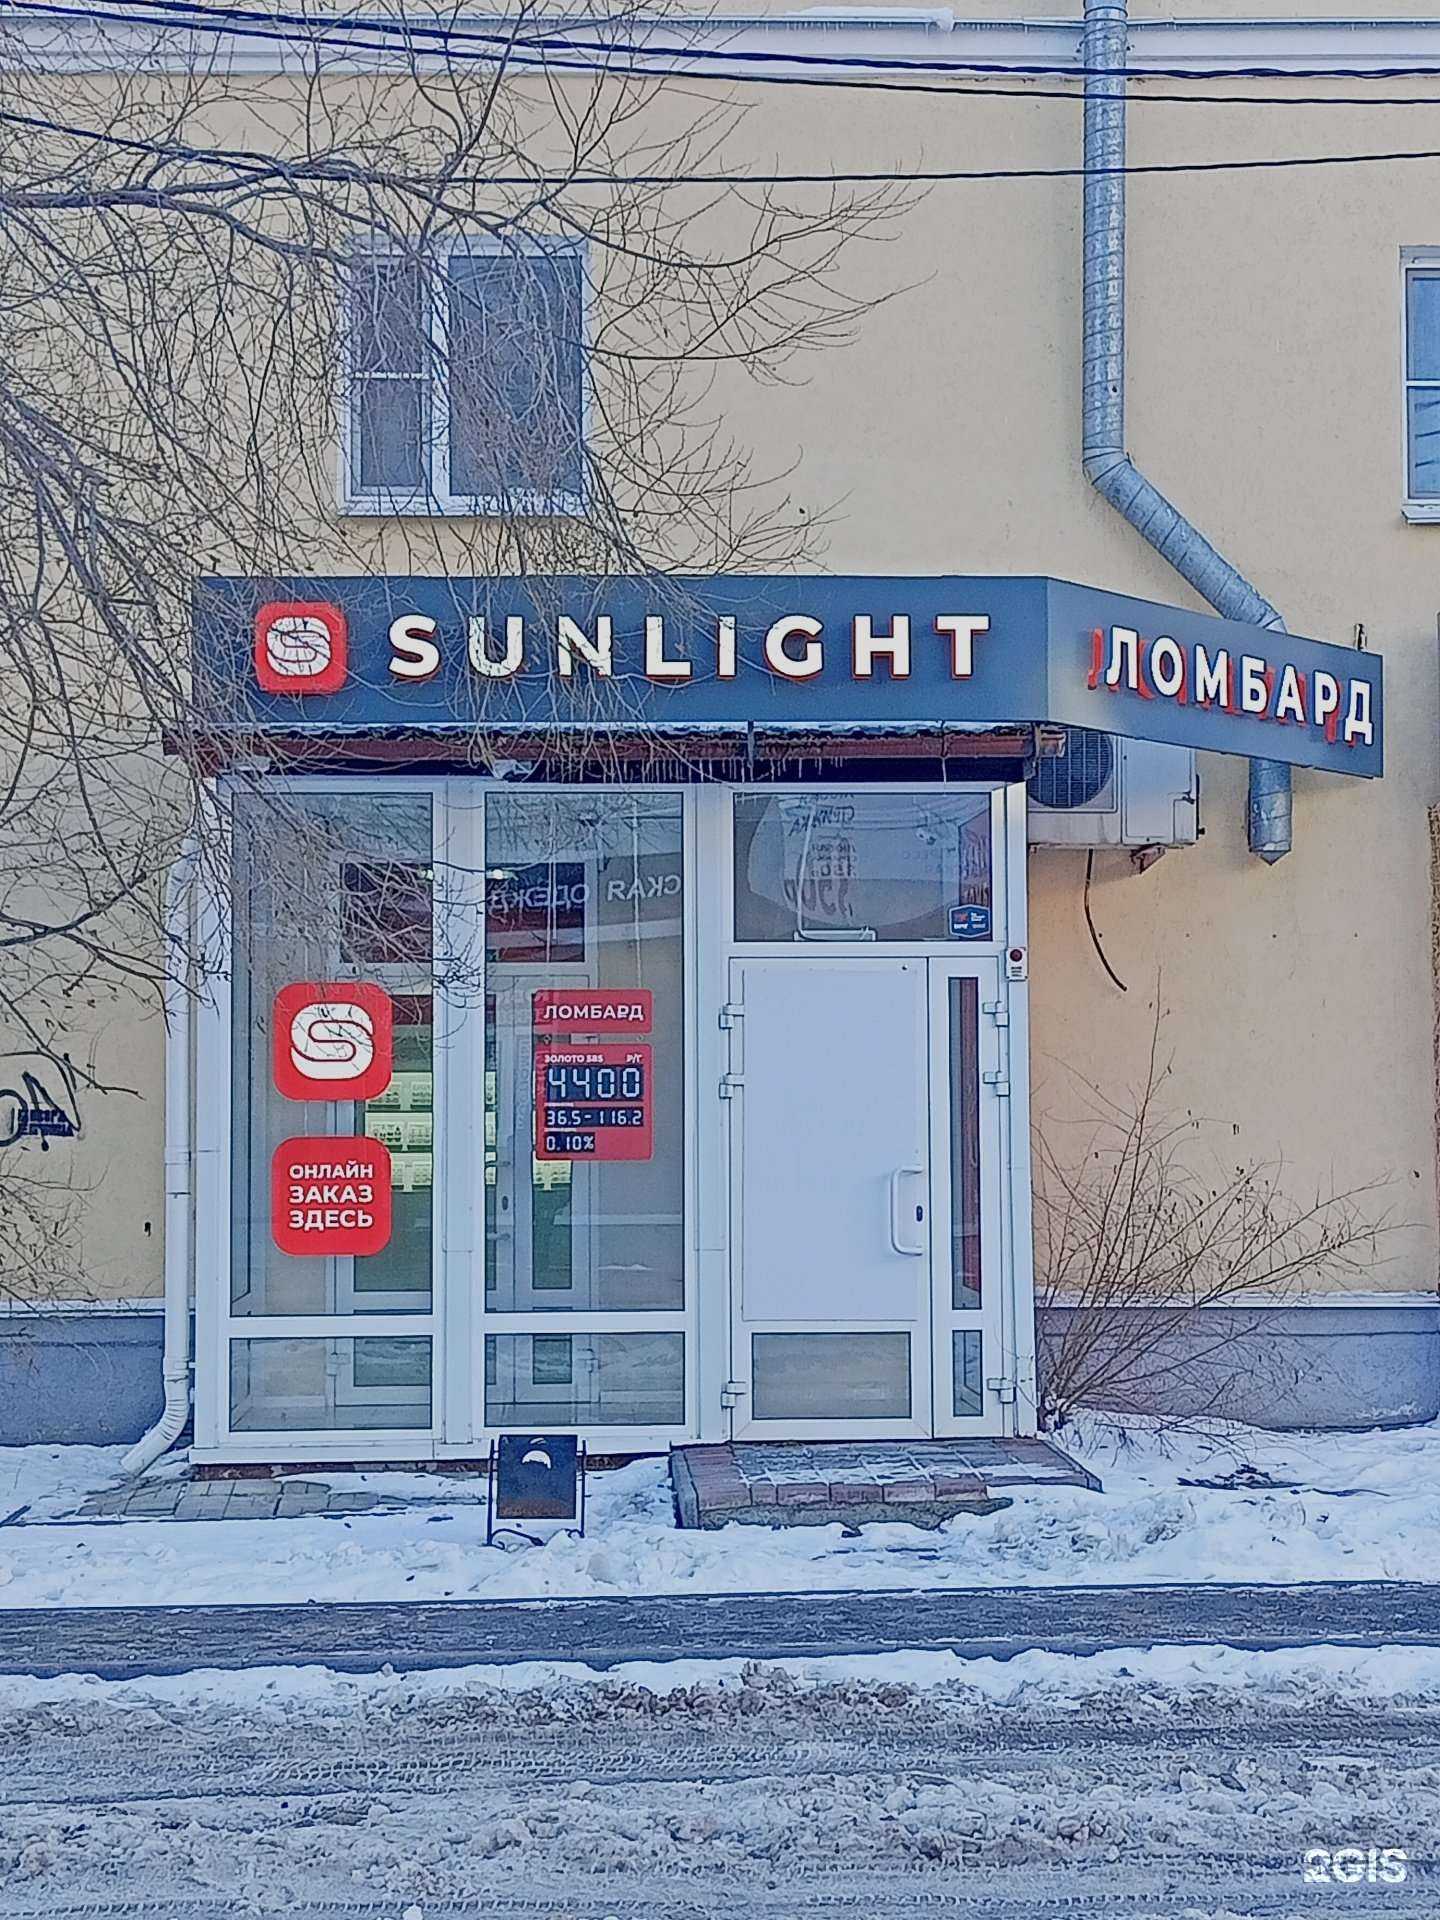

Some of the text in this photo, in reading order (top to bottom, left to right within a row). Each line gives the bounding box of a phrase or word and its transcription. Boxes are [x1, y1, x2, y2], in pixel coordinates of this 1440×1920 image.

[387, 613, 991, 679] SUNLIGHT
[1105, 625, 1374, 746] ЛОМБАРД
[543, 1003, 644, 1021] ЛОМБАРД
[544, 1053, 585, 1064] ЗОЛОТО
[548, 1067, 641, 1099] 4400
[289, 1160, 374, 1180] ОНЛАЙН
[288, 1185, 374, 1204] ЗАКАЗ
[288, 1209, 374, 1231] ЗДЕСЬ
